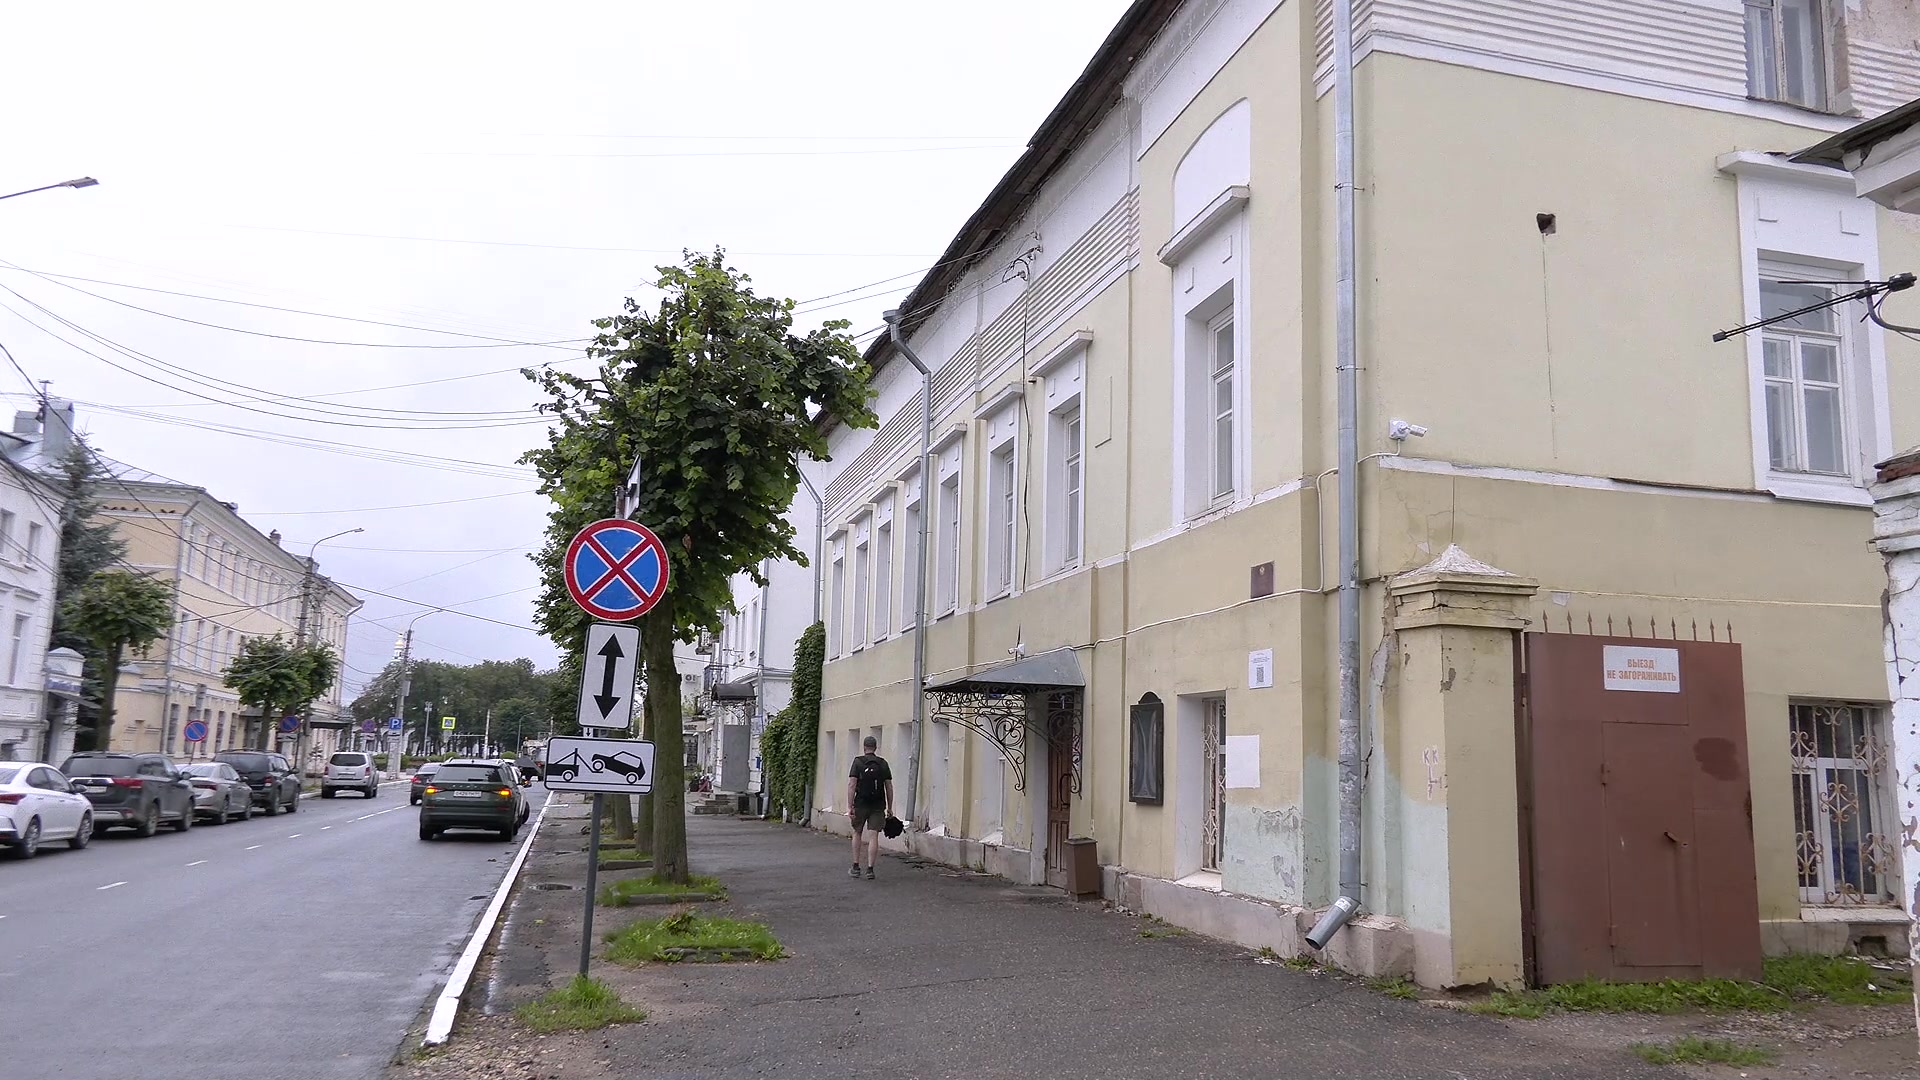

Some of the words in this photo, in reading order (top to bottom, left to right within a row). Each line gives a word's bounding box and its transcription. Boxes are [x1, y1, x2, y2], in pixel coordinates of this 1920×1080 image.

[1627, 658, 1655, 670] ВЫЕЗД
[1606, 669, 1616, 679] НЕ
[1618, 670, 1676, 682] ЗАГОРАЖИВАТЬ
[391, 718, 400, 729] P
